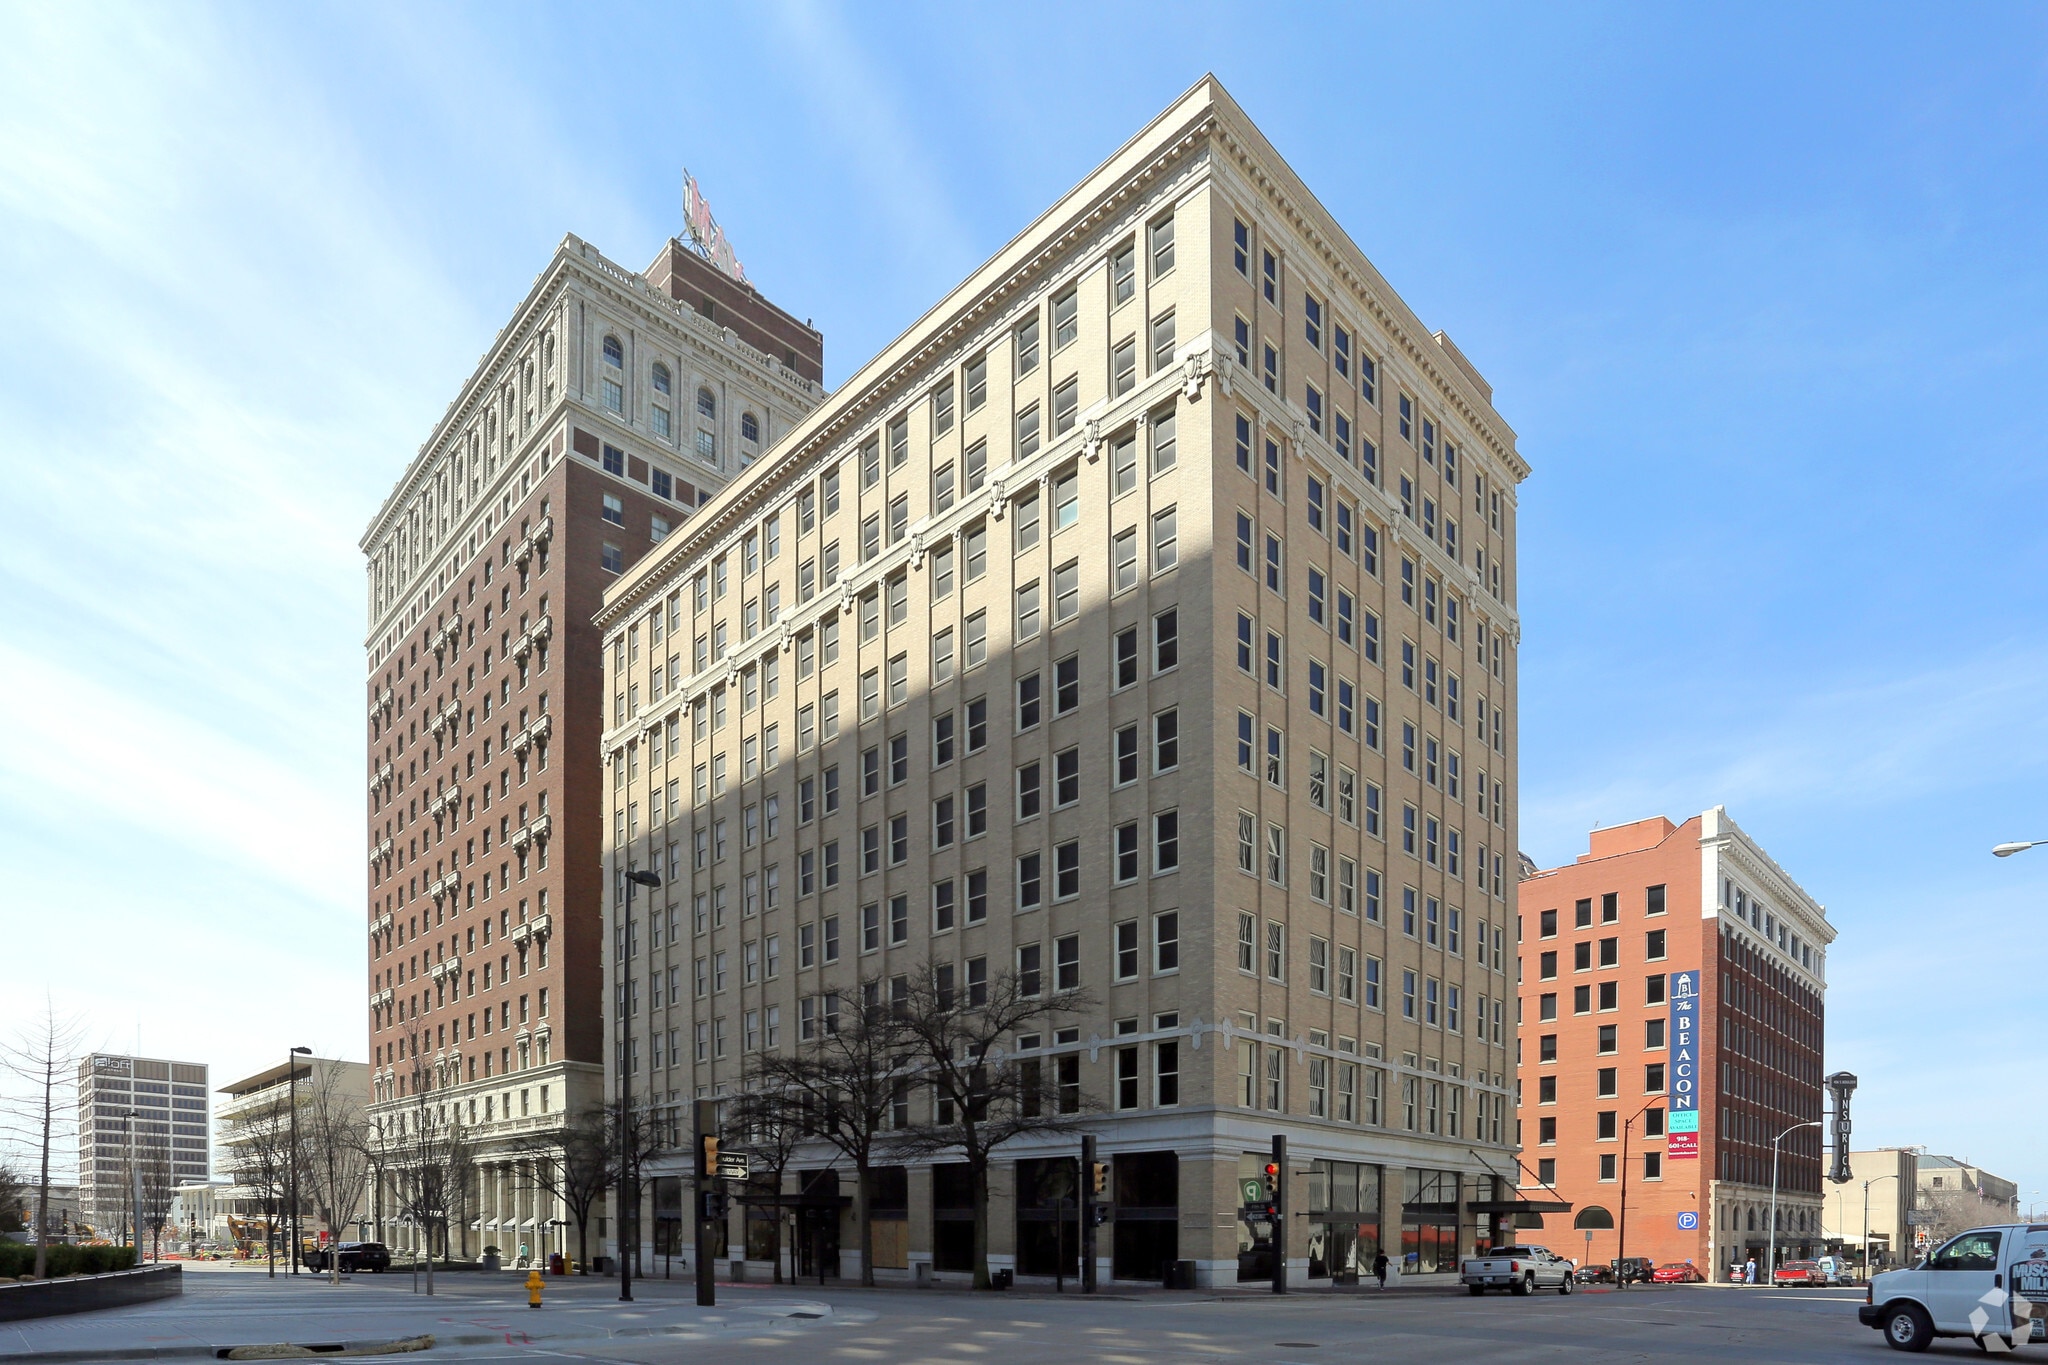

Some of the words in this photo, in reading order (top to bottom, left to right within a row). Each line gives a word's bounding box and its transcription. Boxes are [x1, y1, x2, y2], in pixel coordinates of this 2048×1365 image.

[1682, 984, 1687, 992] B
[1677, 1001, 1692, 1011] The
[1676, 1017, 1691, 1108] BEACON
[1841, 1088, 1849, 1176] INSURICA
[1684, 1216, 1692, 1225] P
[2012, 1263, 2048, 1278] MUSC
